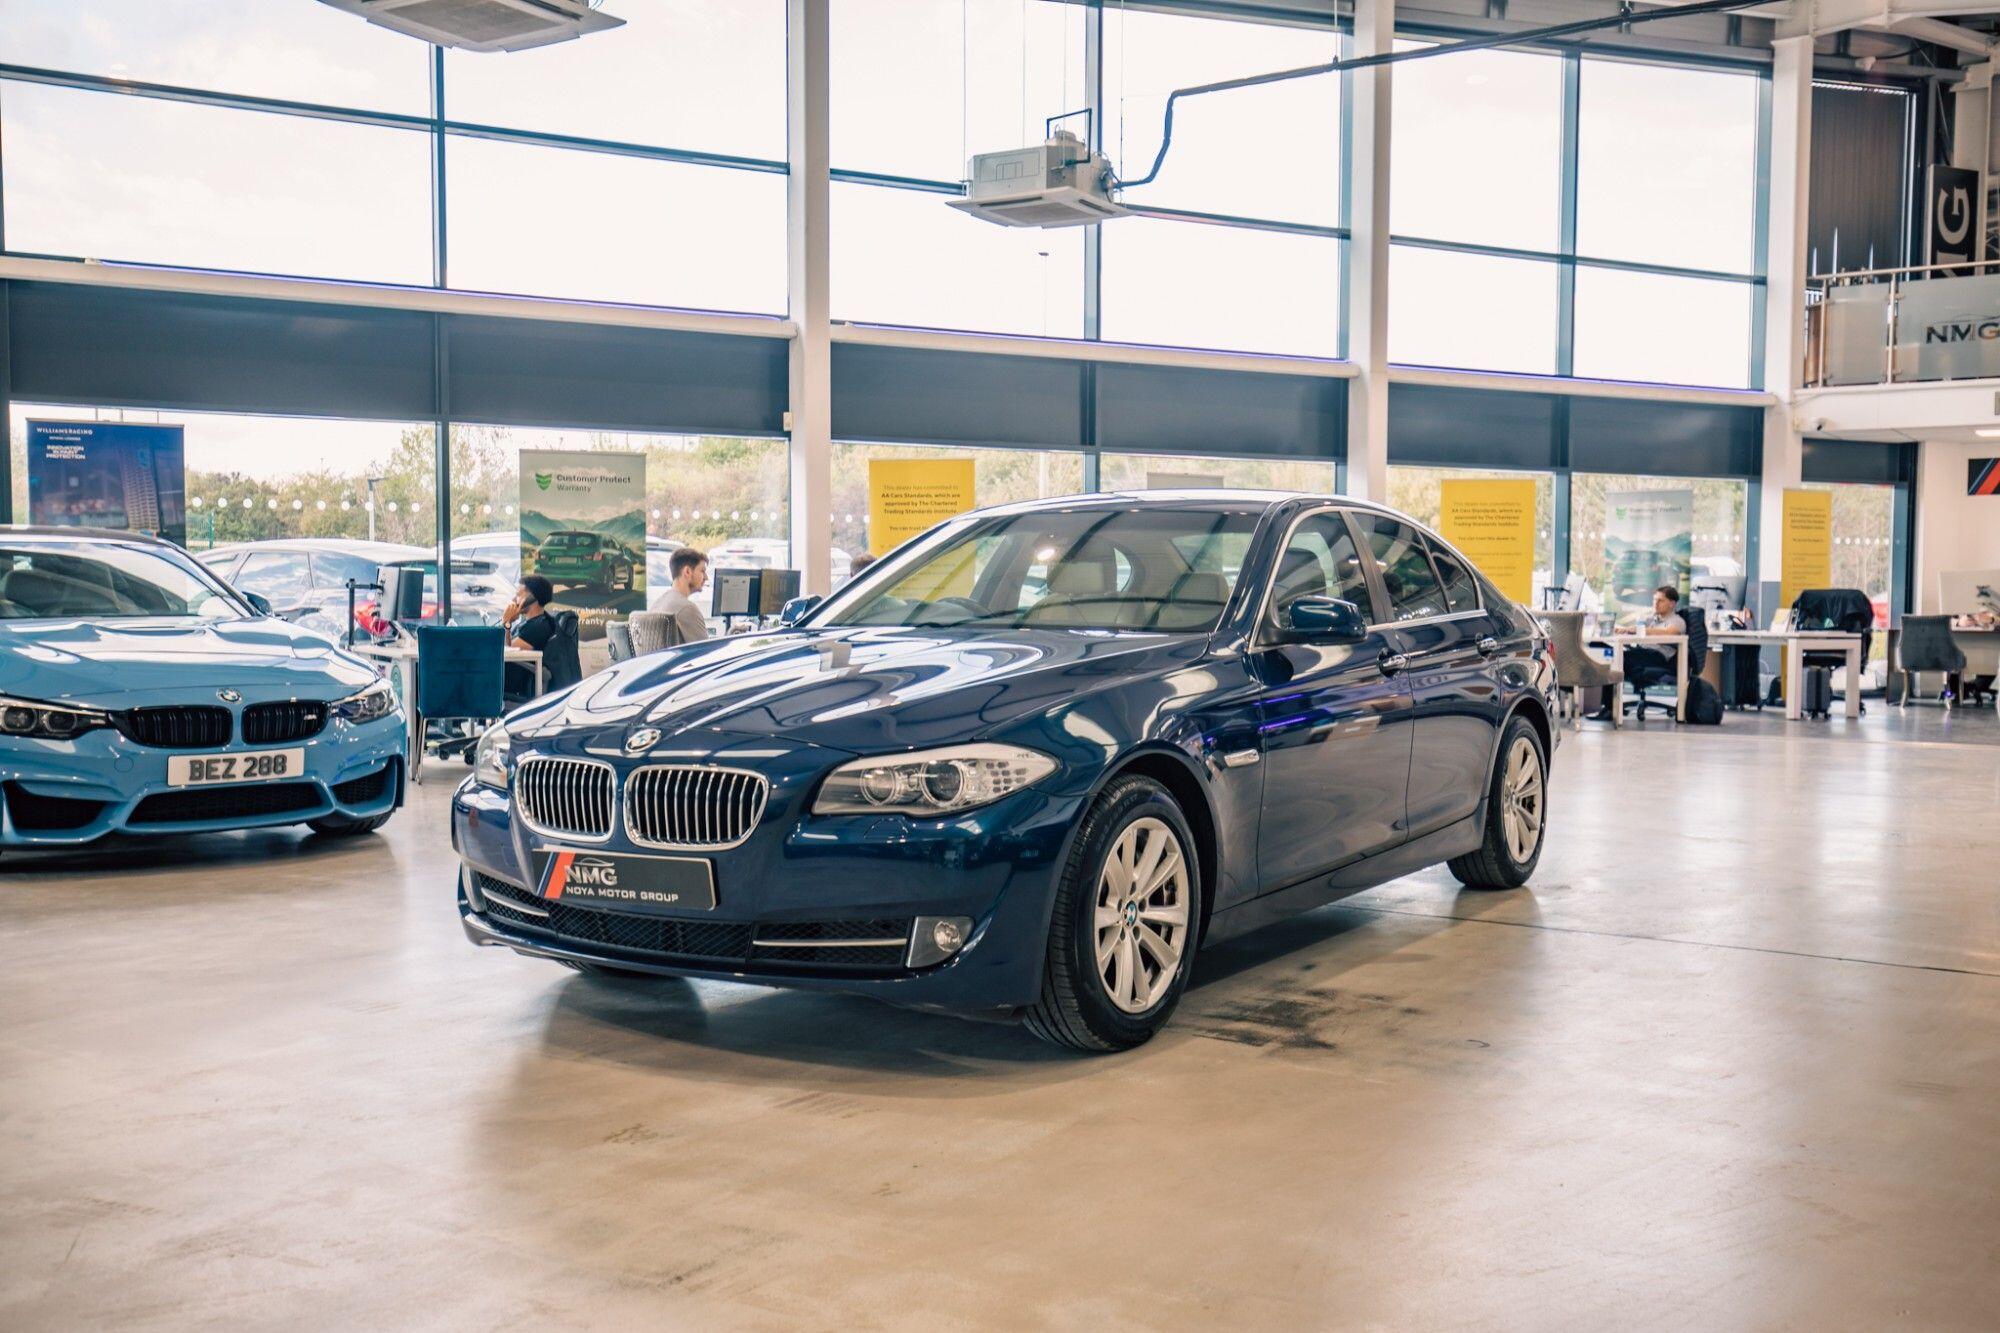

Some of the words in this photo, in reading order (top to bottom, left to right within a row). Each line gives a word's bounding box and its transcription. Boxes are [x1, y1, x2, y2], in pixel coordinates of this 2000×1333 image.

[1926, 323, 2000, 343] NMG
[557, 474, 597, 483] Customer
[600, 475, 631, 484] Protect
[557, 484, 591, 493] Warranty
[552, 606, 618, 616] Crehensive
[189, 758, 237, 782] BEZ
[243, 753, 288, 777] 288
[565, 865, 618, 886] NMG
[566, 886, 594, 896] NOYA
[599, 889, 637, 900] MOTOR
[641, 892, 679, 903] GROUP
